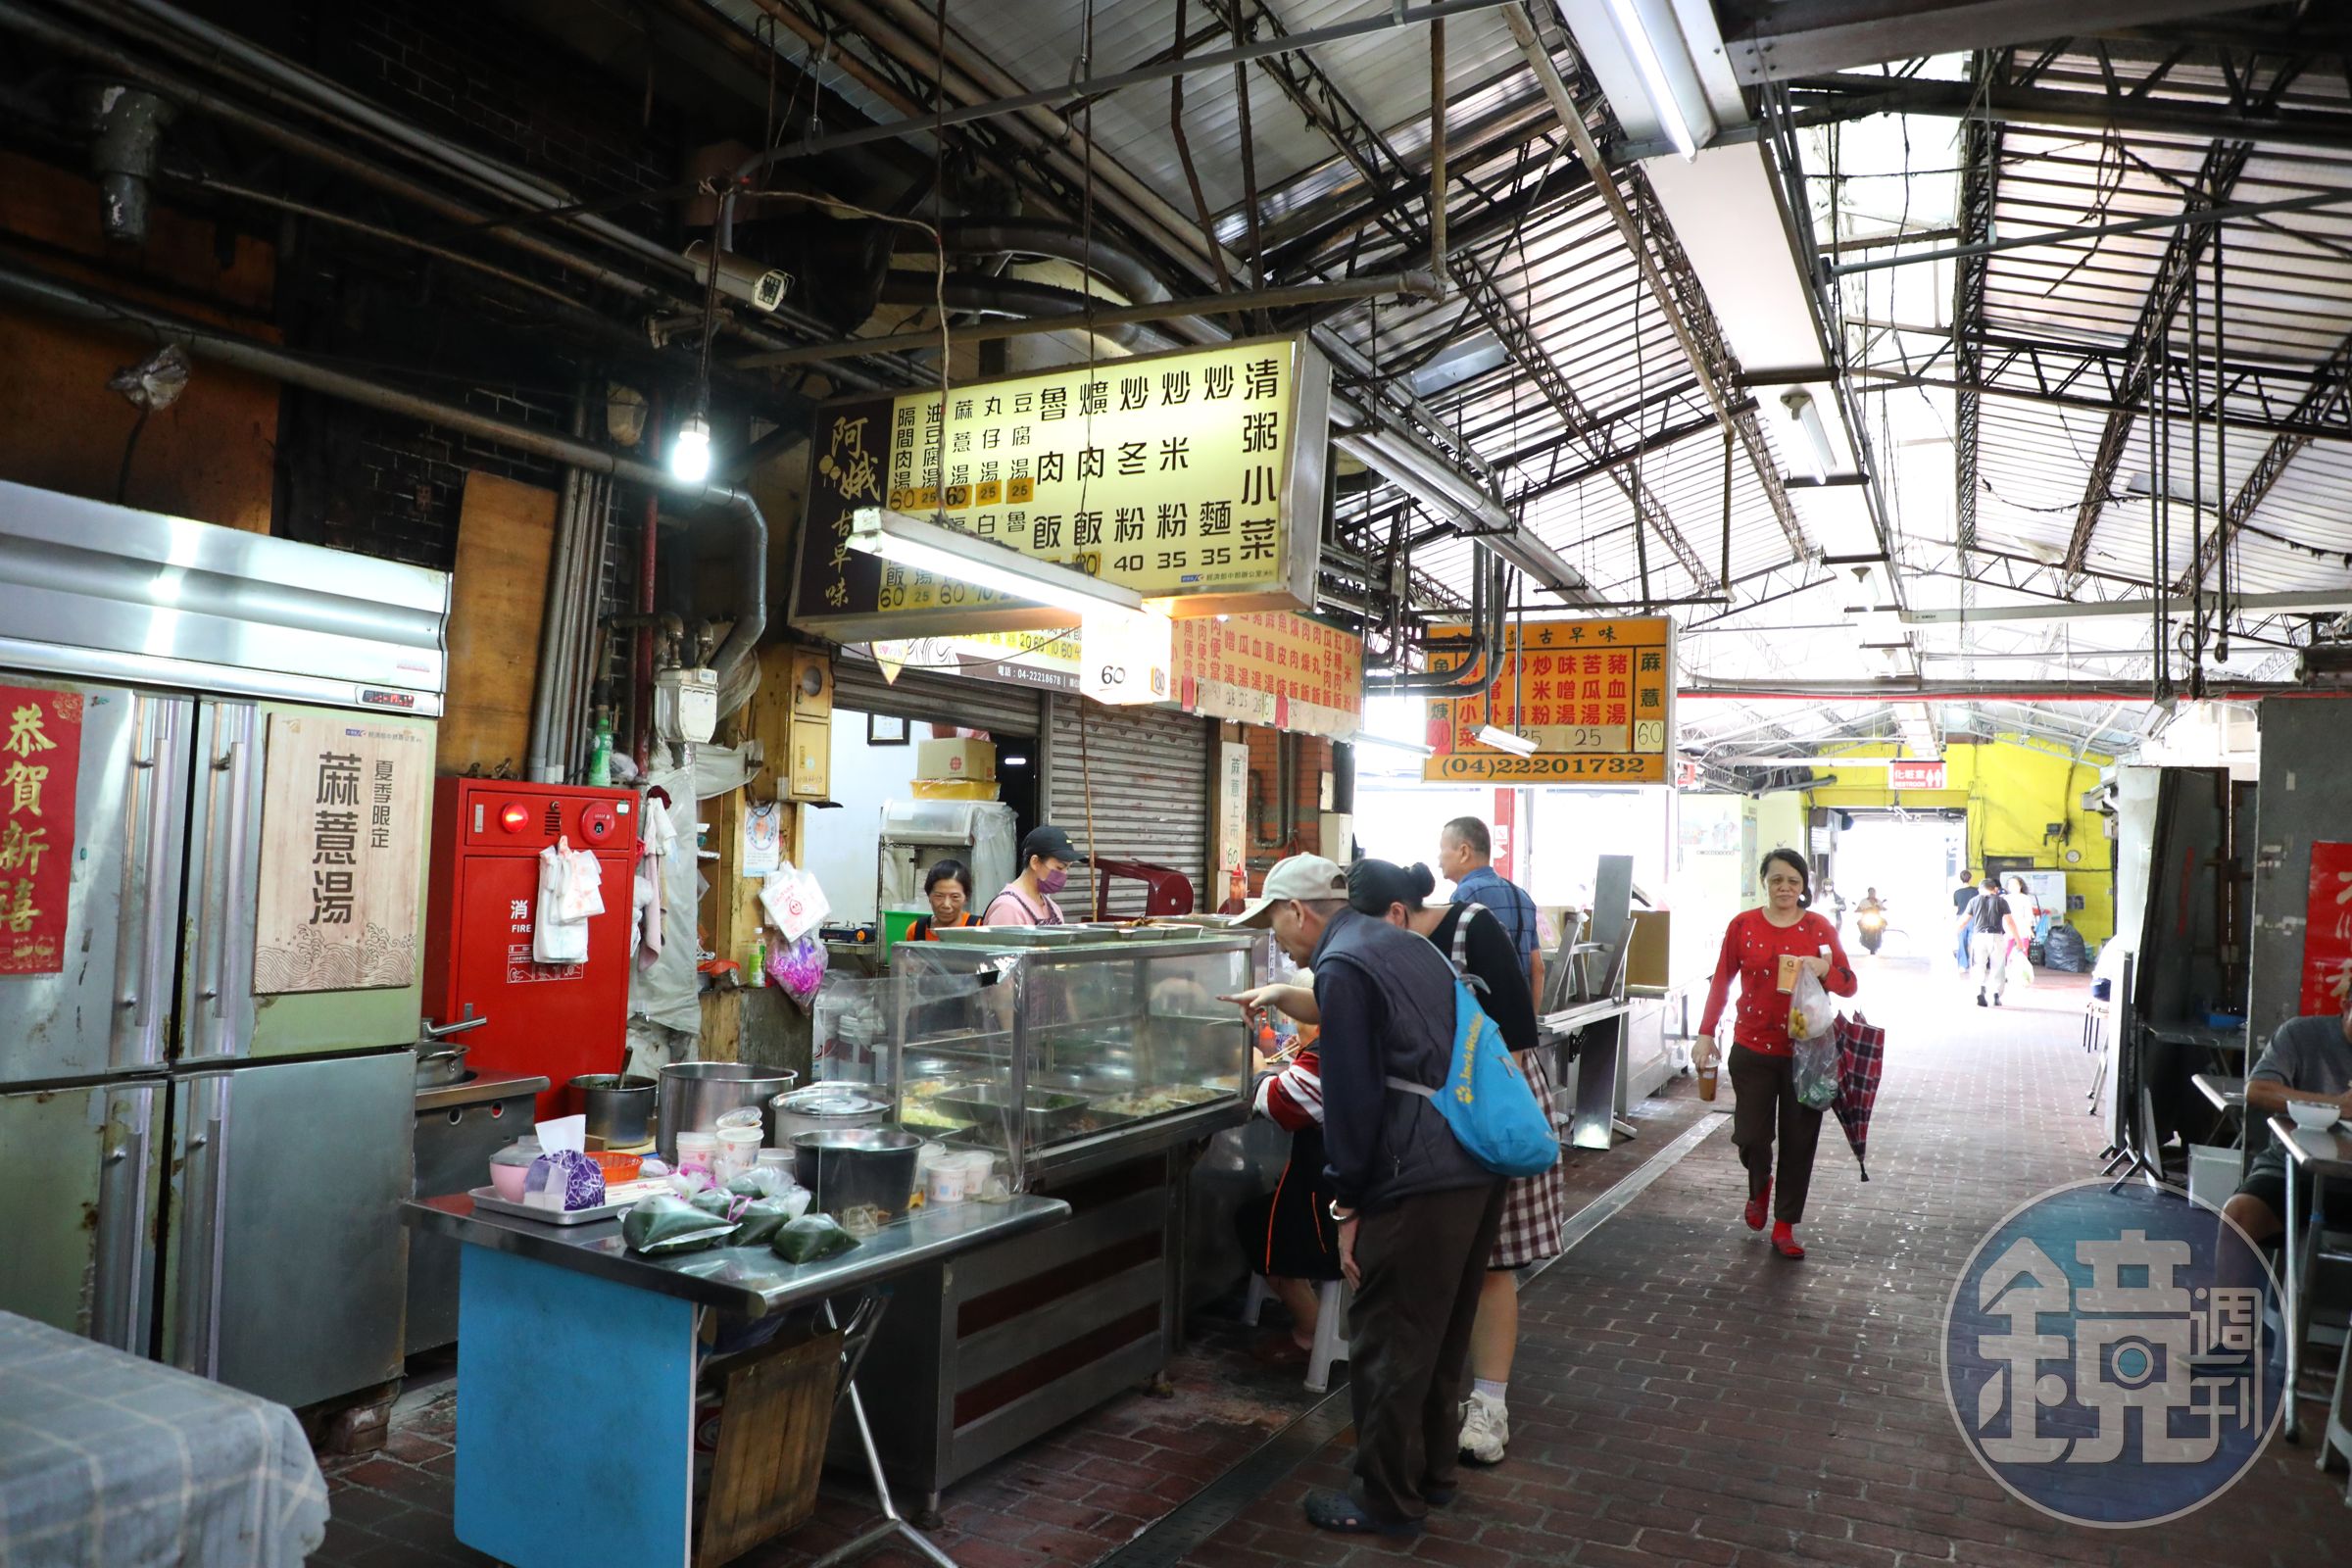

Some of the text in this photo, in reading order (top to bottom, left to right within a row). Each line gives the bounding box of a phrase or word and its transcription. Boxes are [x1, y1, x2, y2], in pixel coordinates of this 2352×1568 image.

[894, 407, 916, 490] 隔間肉湯
[980, 396, 1002, 482] 丸仔湯
[1011, 392, 1033, 479] 豆腐湯
[1033, 387, 1067, 550] 魯肉飯
[1114, 376, 1150, 543] 炒冬粉
[1156, 370, 1191, 540] 炒米粉
[1200, 365, 1234, 537] 炒麵
[1241, 360, 1279, 560] 清粥小菜
[890, 490, 914, 511] 60
[921, 492, 937, 504] 25
[980, 487, 996, 499] 25
[1011, 485, 1028, 497] 25
[825, 509, 854, 609] 古早味
[1114, 555, 1144, 571] 40
[1157, 552, 1187, 569] 35
[1201, 548, 1231, 565] 35
[880, 587, 905, 608] 60
[915, 591, 930, 603] 25
[941, 584, 965, 605] 60
[1101, 664, 1125, 685] 60
[1531, 657, 1552, 726] 炒米粉
[1556, 655, 1577, 726] 味噌湯
[1581, 654, 1602, 726] 苦瓜湯
[1606, 654, 1628, 725] 豬血湯
[1442, 757, 1645, 778] (04)22201732
[1574, 728, 1601, 747] 25
[1638, 721, 1663, 746] 60
[0, 703, 57, 932] 恭賀新禧
[310, 751, 362, 924] 蔴薏湯
[370, 760, 393, 849] 夏季限定
[512, 924, 531, 933] FIRE
